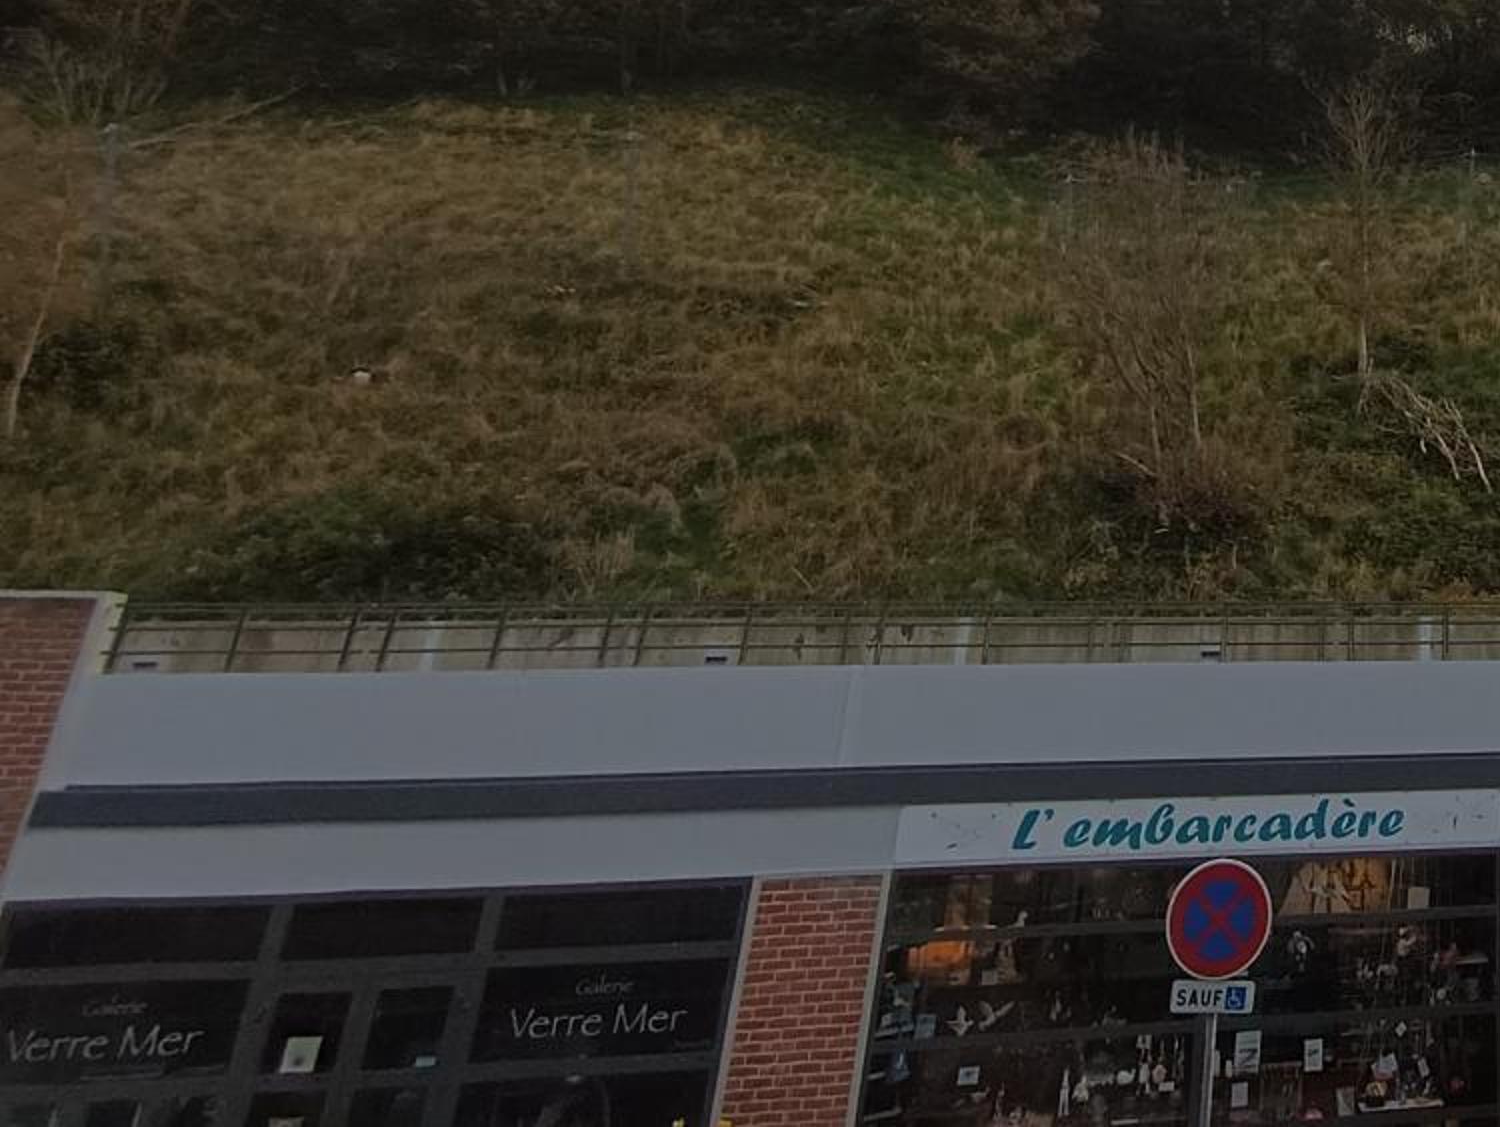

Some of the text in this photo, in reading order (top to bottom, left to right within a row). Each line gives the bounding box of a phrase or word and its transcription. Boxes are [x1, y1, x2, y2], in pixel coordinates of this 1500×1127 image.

[1176, 988, 1223, 1007] SAUF
[509, 1002, 689, 1040] Verre Mer
[7, 1024, 205, 1063] Verre Mer
